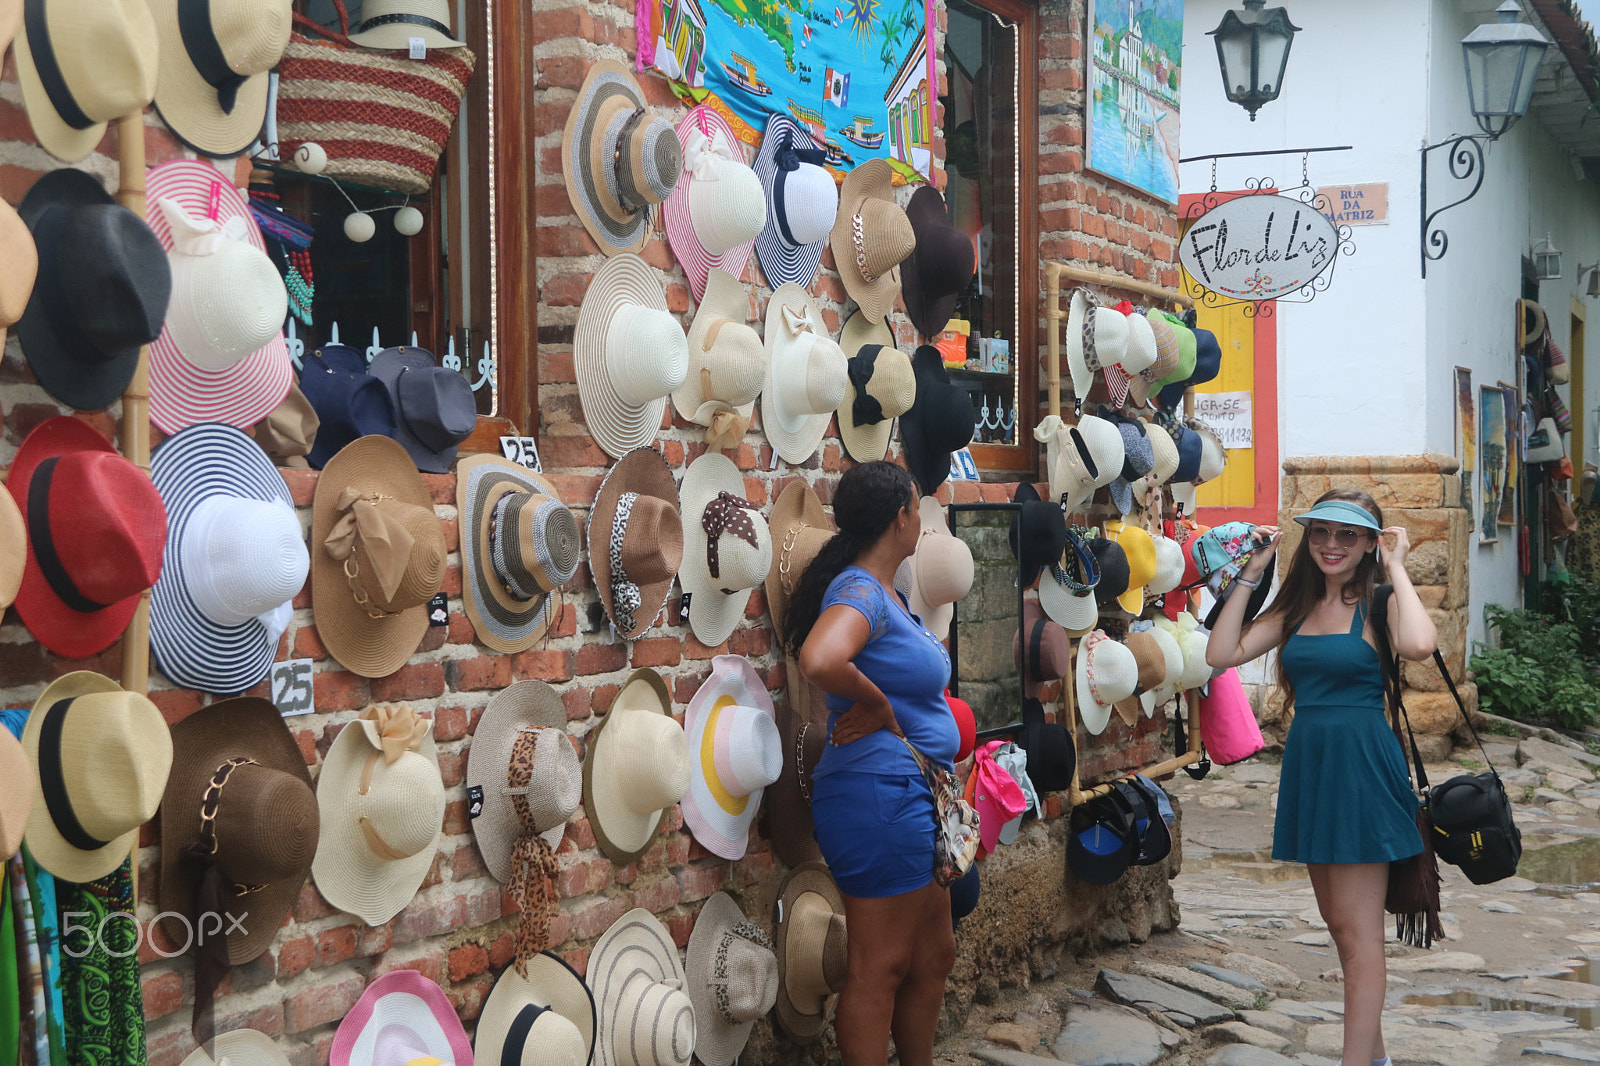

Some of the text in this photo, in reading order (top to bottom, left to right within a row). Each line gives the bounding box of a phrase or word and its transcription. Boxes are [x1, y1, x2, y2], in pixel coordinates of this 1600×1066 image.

[1340, 190, 1364, 200] RUA
[1343, 200, 1361, 210] DA
[1190, 218, 1251, 284] Flor
[1284, 210, 1327, 269] Liz
[1194, 399, 1241, 410] UGA-SE
[273, 664, 313, 713] 25
